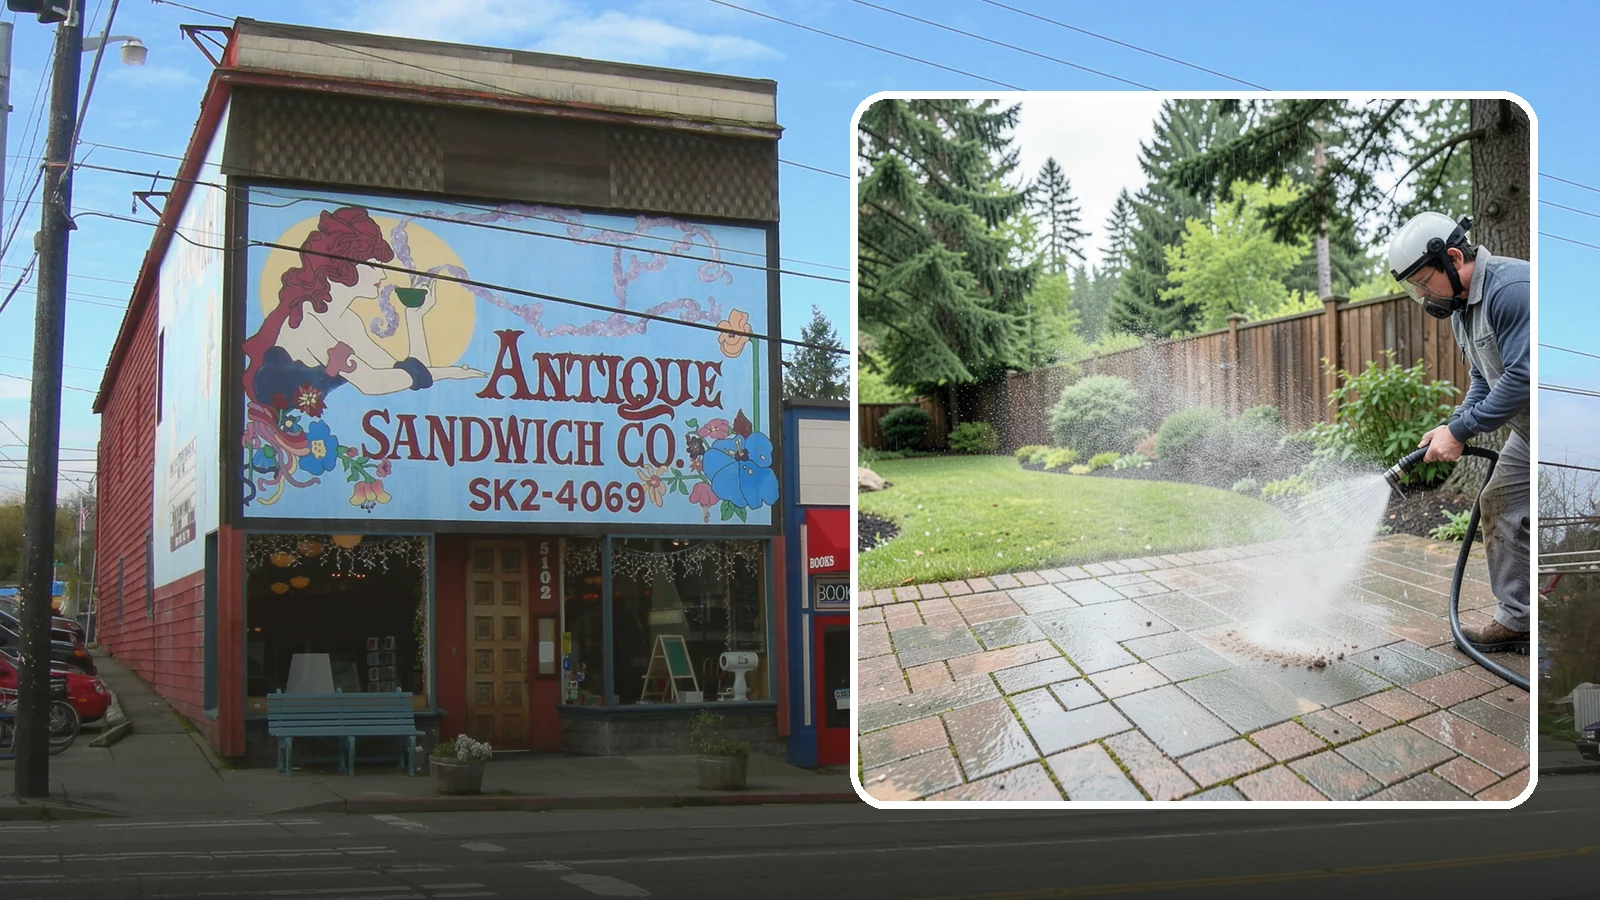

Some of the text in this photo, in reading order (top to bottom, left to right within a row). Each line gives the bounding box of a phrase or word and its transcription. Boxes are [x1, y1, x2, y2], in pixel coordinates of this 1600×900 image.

[476, 328, 724, 421] ANTIQUE
[361, 408, 685, 468] SANDWICH CO.
[468, 477, 645, 513] SK2-4069
[540, 541, 551, 600] 5102
[809, 555, 835, 569] BOOKS
